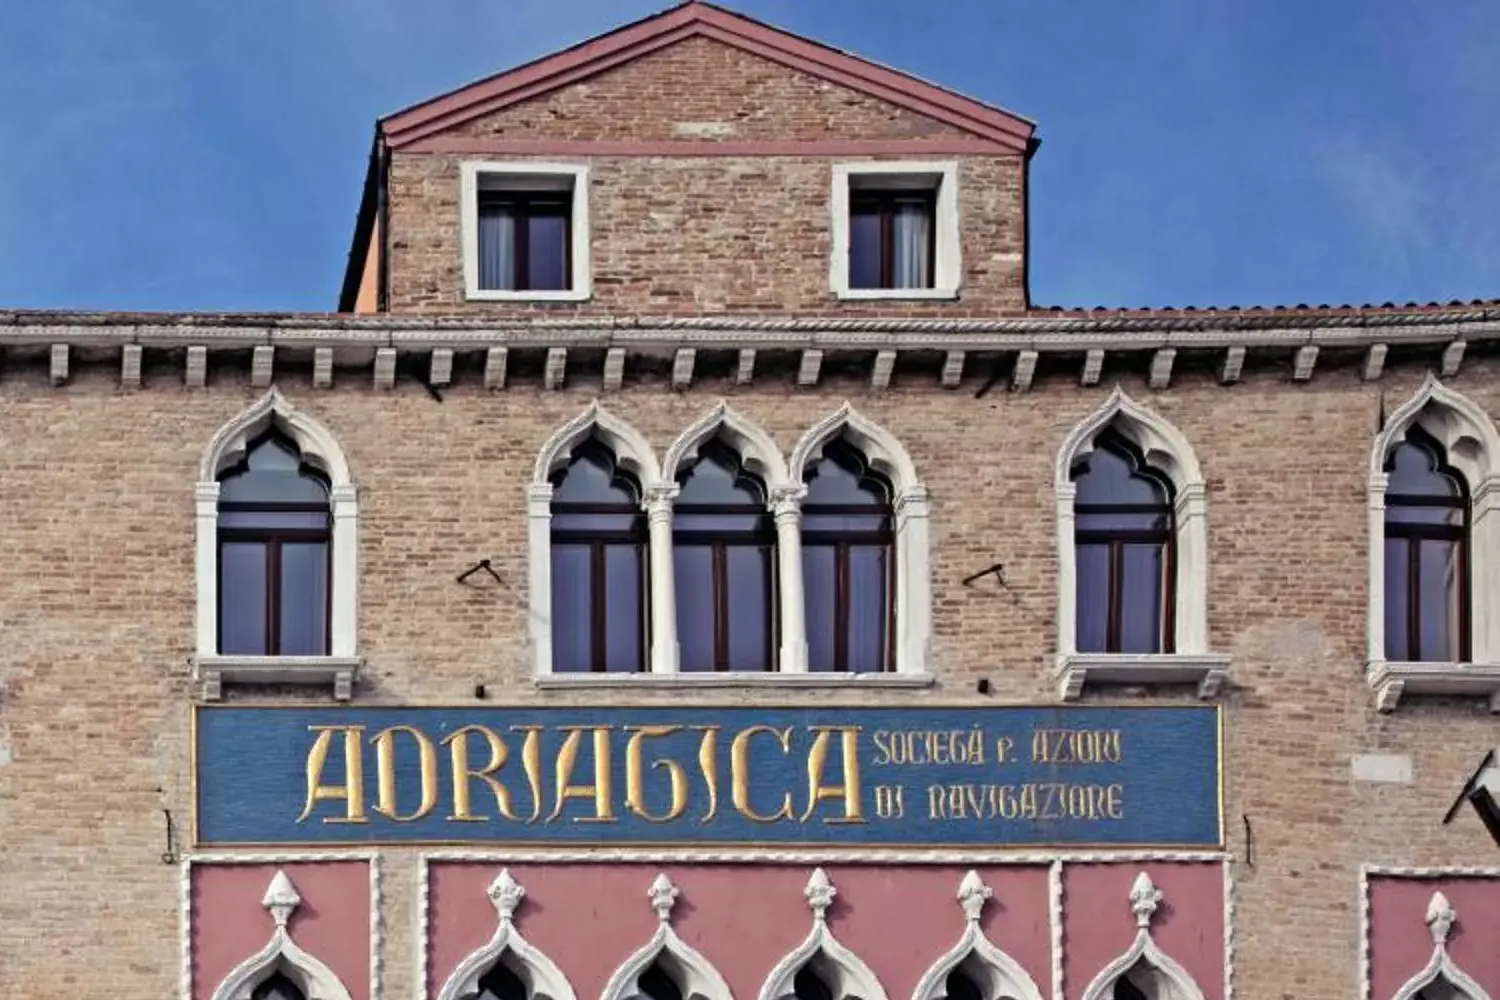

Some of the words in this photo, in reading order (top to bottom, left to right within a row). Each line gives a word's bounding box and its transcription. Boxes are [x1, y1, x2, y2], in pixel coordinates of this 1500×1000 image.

[295, 724, 868, 824] ADRIATICA
[875, 784, 904, 819] DI
[928, 783, 1125, 820] NAVIGAZIONE
